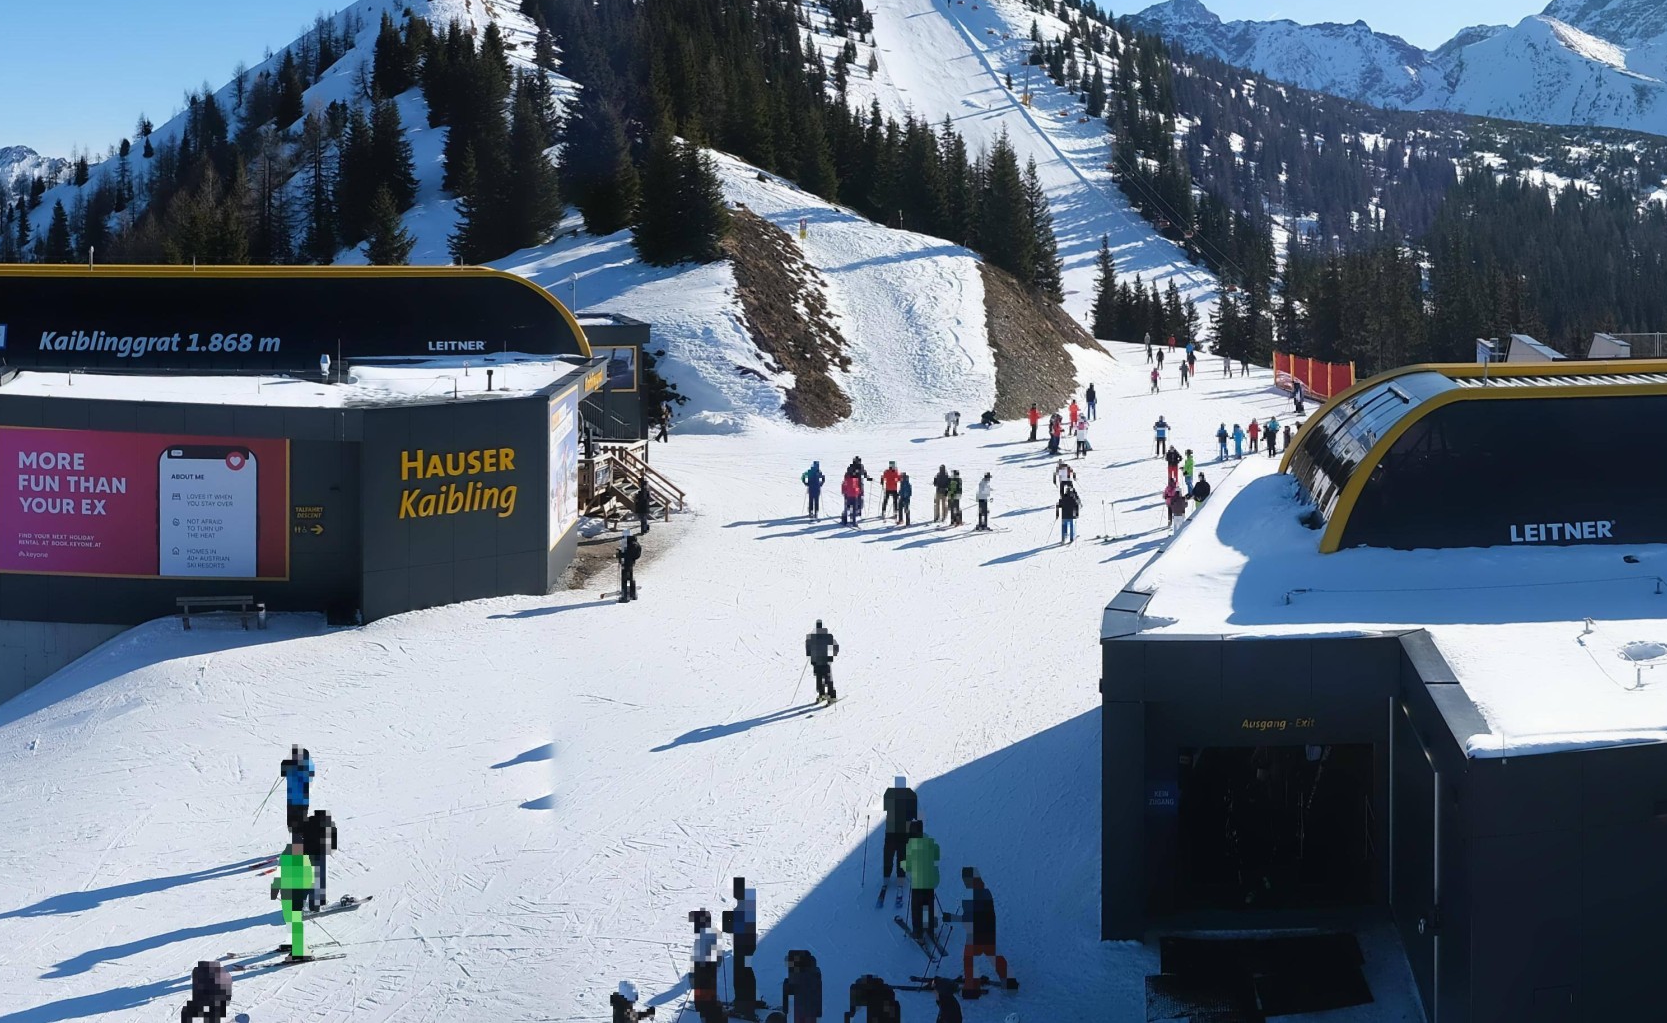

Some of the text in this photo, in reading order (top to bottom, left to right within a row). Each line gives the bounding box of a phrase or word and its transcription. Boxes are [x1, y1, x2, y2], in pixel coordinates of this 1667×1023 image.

[39, 330, 280, 357] Kaiblinggrat 1.868 m
[428, 340, 485, 351] LEITNER
[18, 451, 85, 470] MORE
[401, 448, 516, 480] HAUSER
[18, 474, 126, 494] FUN THAN
[19, 497, 107, 515] YOUR EX
[398, 481, 518, 519] Kaibling
[1510, 520, 1613, 542] LEITNER
[25, 551, 49, 559] keyone
[1241, 718, 1286, 731] Ausgang
[1295, 717, 1316, 727] Exit
